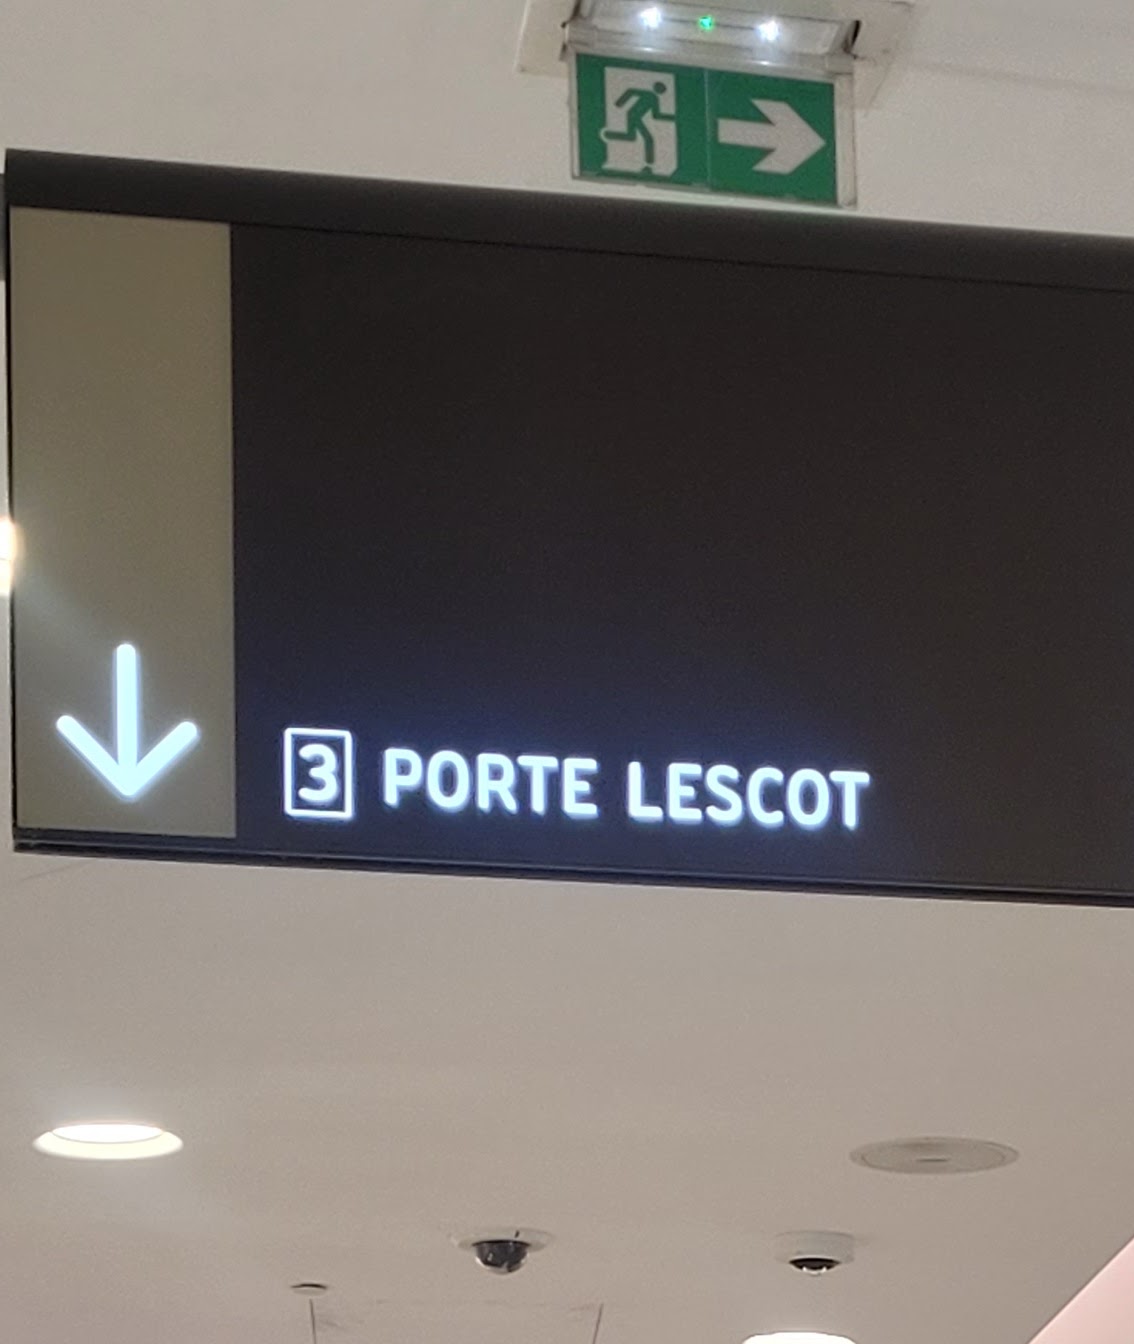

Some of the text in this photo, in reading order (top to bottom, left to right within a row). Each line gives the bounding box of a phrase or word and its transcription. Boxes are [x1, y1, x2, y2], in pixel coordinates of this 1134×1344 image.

[297, 744, 870, 830] 3 PORTE LESCOT
